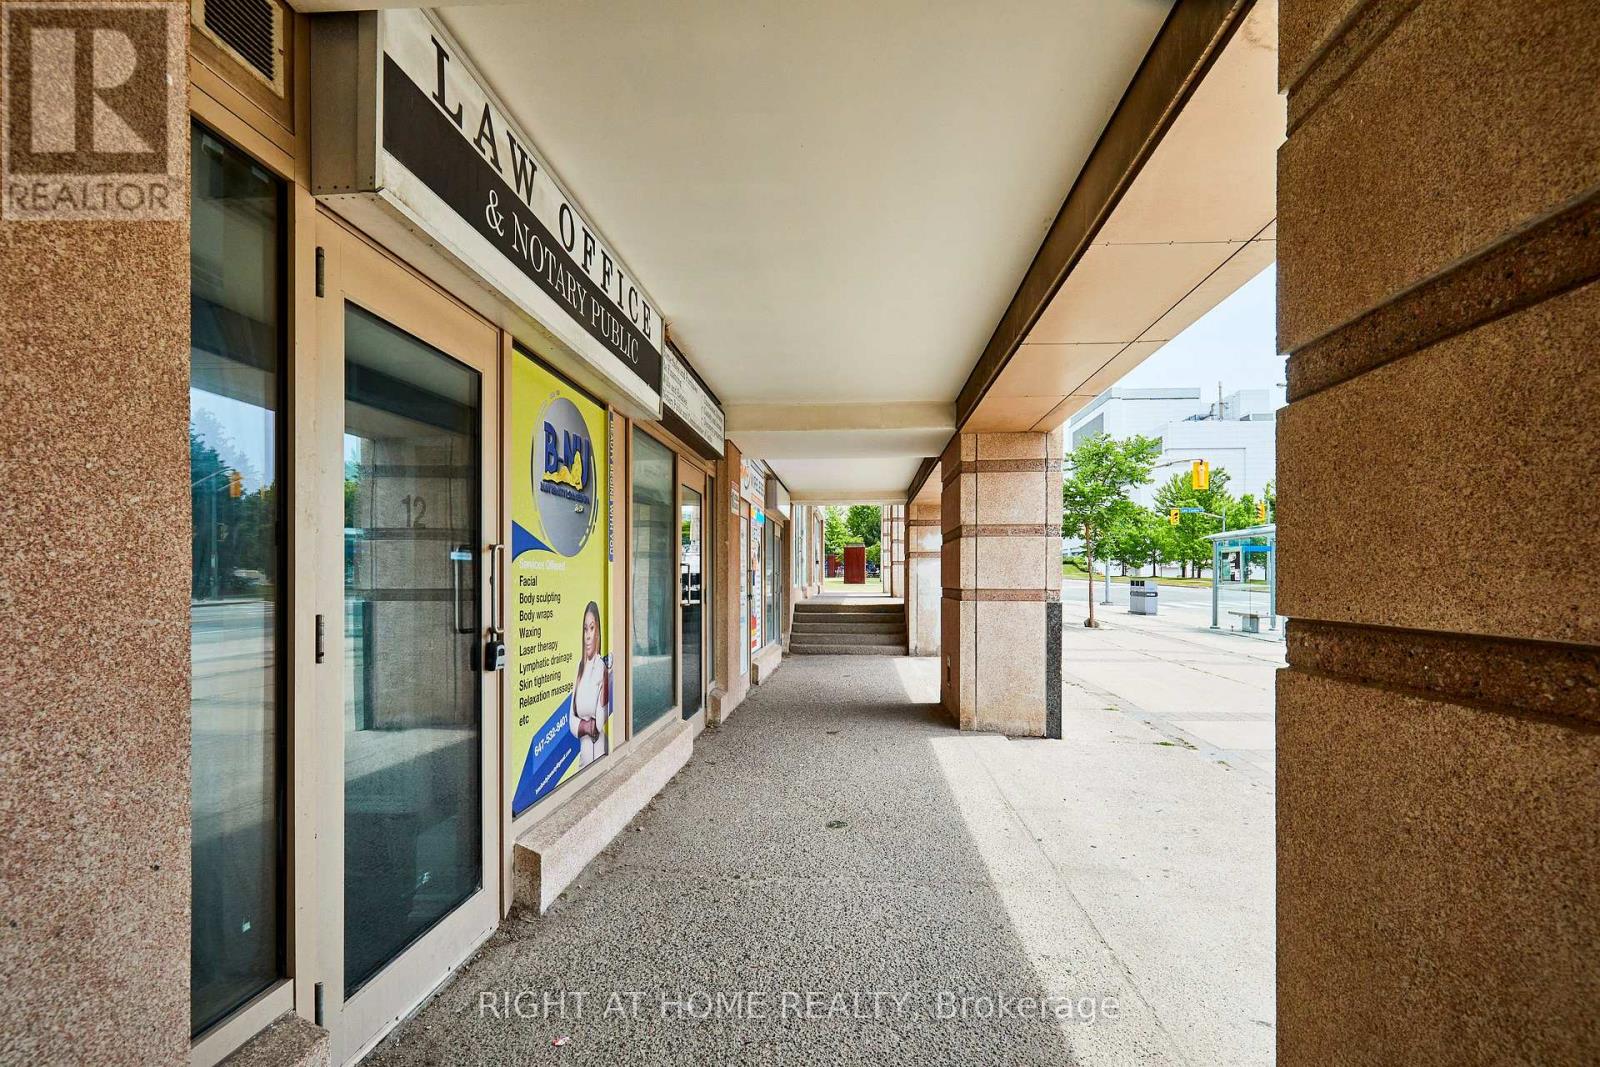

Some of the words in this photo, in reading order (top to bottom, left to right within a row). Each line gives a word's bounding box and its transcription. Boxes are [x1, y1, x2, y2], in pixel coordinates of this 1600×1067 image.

[430, 34, 538, 207] LAW
[558, 203, 652, 340] OFFICE
[485, 189, 504, 236] &
[512, 211, 587, 315] NOTARY
[590, 294, 640, 365] PUBLIC
[400, 494, 427, 529] 12
[519, 574, 538, 587] Facial
[519, 592, 535, 606] Body
[536, 591, 561, 605] sculpting
[519, 609, 535, 622] Body
[536, 609, 554, 621] wraps
[519, 626, 542, 639] Waxing
[519, 645, 537, 657] Laser
[537, 640, 558, 652] therapy
[519, 656, 550, 676] Lymphatic
[550, 652, 573, 666] drainage
[519, 678, 533, 692] Skin
[533, 670, 562, 688] tightening
[519, 689, 551, 709] Relaxation
[550, 682, 574, 697] massage
[518, 714, 530, 727] etc
